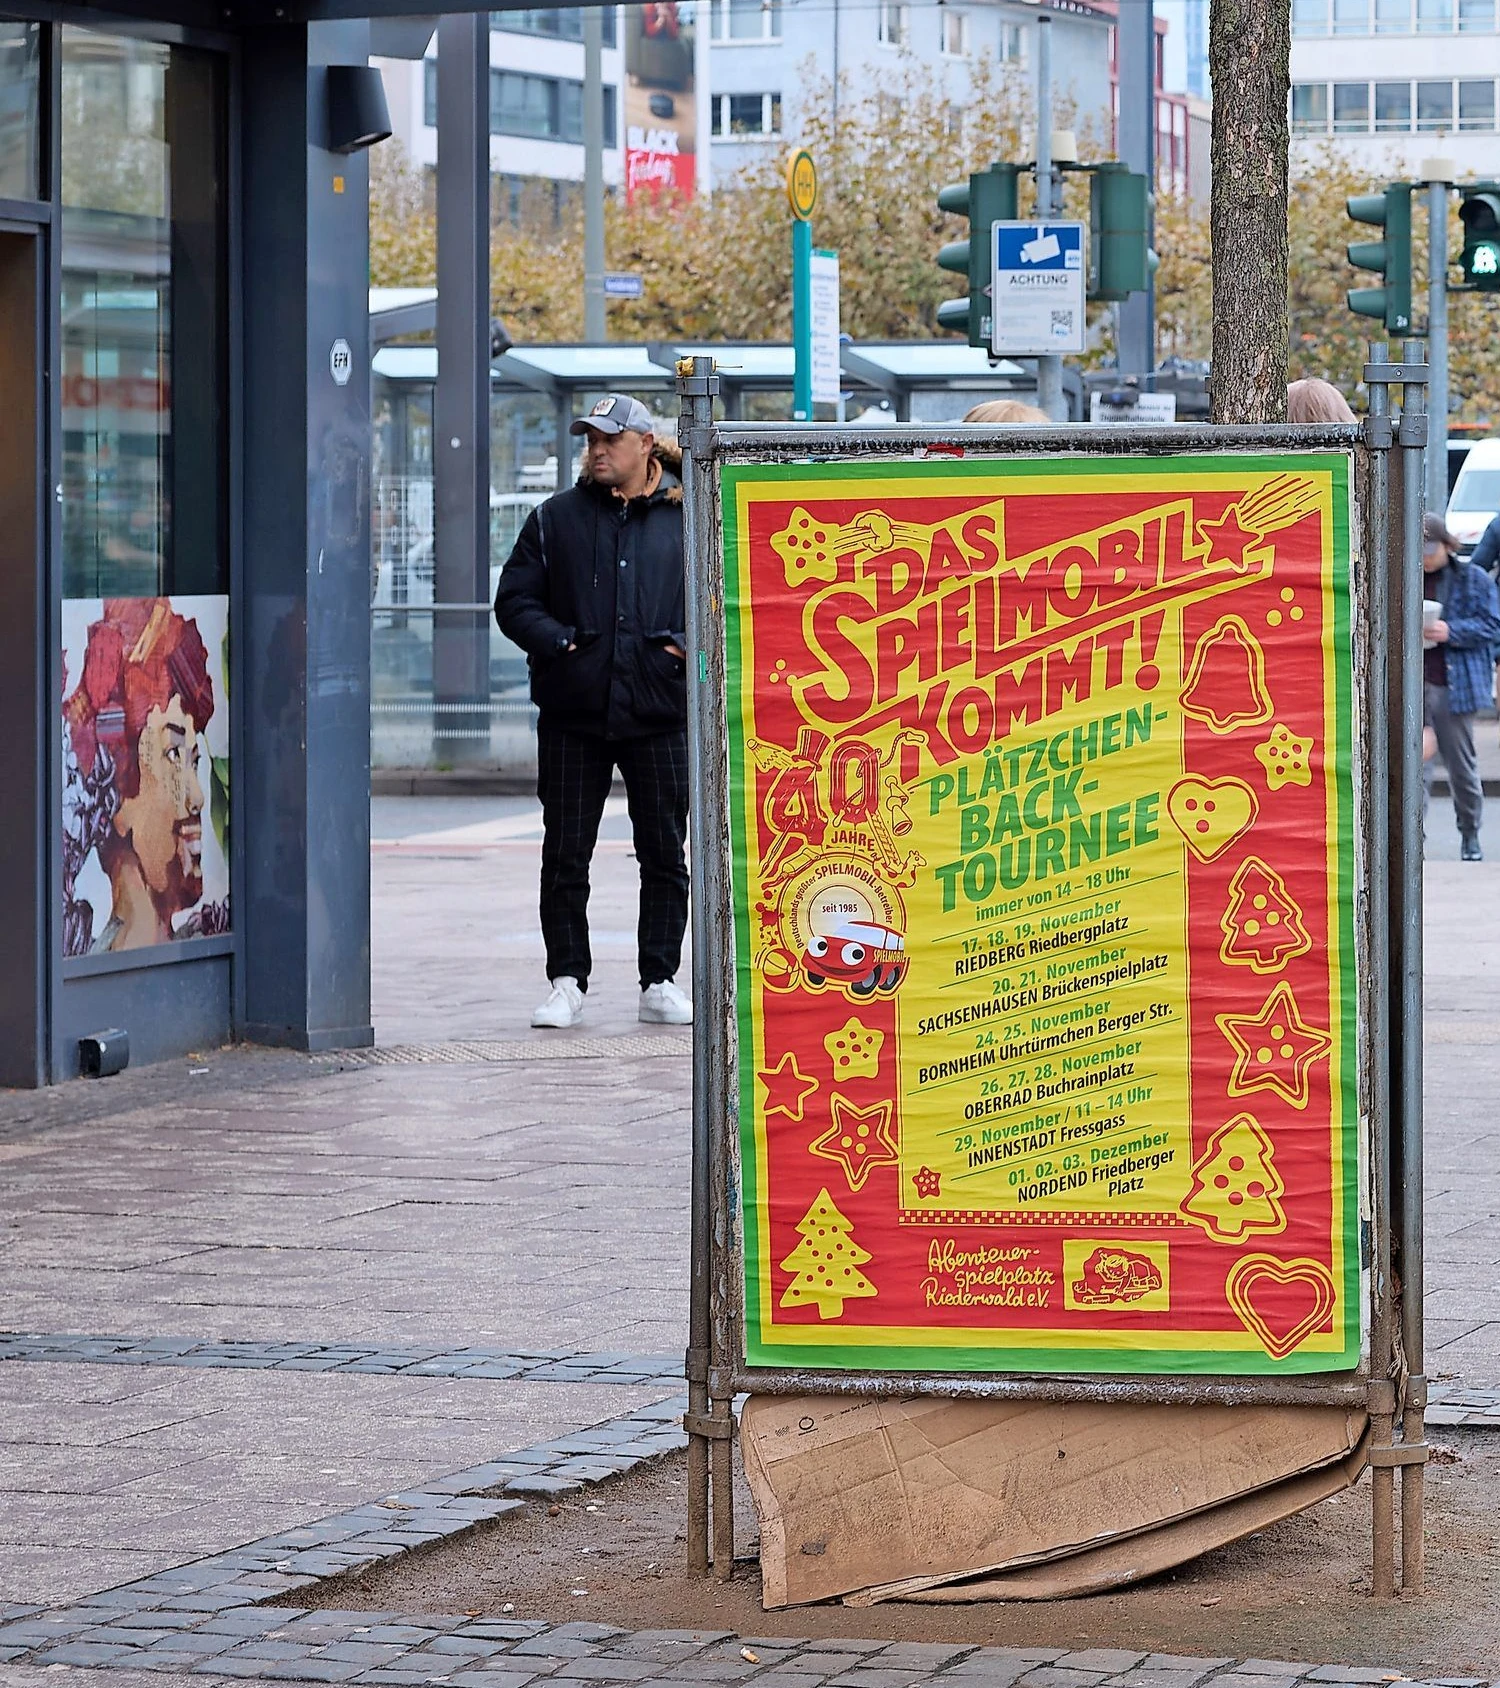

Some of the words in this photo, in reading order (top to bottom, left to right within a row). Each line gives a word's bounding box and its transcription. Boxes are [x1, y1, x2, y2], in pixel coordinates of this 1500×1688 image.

[1009, 275, 1069, 285] ACHTUNG
[863, 515, 999, 613] DAS
[802, 510, 1206, 723] SPIELMOBIL
[838, 609, 1166, 785] KOMMT!
[920, 702, 1168, 816] PLÄTZCHEN-
[960, 767, 1098, 855] BACK-
[831, 830, 875, 852] JAHRE
[935, 791, 1160, 913] TOURNEE
[795, 875, 816, 901] größter
[822, 904, 838, 913] seit
[839, 904, 858, 913] 1985
[976, 899, 1023, 921] immer
[1026, 891, 1052, 908] von
[1055, 882, 1071, 900] 14
[1085, 873, 1102, 891] 18
[1105, 866, 1131, 884] Uhr
[789, 900, 805, 949] Deutschlands
[955, 943, 1026, 976] RIEDBERG
[1029, 917, 1129, 956] Riedbergplatz
[962, 939, 982, 955] 17.
[987, 931, 1009, 949] 18.
[1014, 923, 1036, 940] 19.
[1040, 898, 1121, 932] November
[917, 988, 1038, 1036] SACHSENHAUSEN
[1042, 954, 1168, 1001] Brückenspielplatz
[992, 978, 1015, 995] 20.
[1020, 970, 1042, 987] 21.
[1046, 946, 1127, 980] November
[919, 1048, 996, 1084] BORNHEIM
[999, 1024, 1094, 1061] Uhrtürmchen
[1098, 1013, 1146, 1035] Berger
[1149, 1002, 1173, 1020] Str.
[975, 1032, 999, 1049] 24.
[1003, 1023, 1026, 1041] 25.
[1031, 999, 1111, 1034] November
[964, 1088, 1032, 1120] OBERRAD
[1036, 1061, 1135, 1100] Buchrainplatz
[980, 1081, 1004, 1097] 26.
[1008, 1072, 1030, 1088] 27.
[1034, 1064, 1057, 1080] 28.
[1062, 1040, 1142, 1074] November
[954, 1137, 977, 1153] 29.
[982, 1110, 1061, 1146] November
[1064, 1106, 1071, 1124] /
[1075, 1103, 1091, 1119] 11
[1107, 1093, 1123, 1110] 14
[1127, 1086, 1153, 1105] Uhr
[968, 1130, 1056, 1168] INNENSTADT
[1060, 1113, 1126, 1144] Fressgass
[1008, 1170, 1031, 1187] 01.
[1035, 1162, 1058, 1179] 02.
[1063, 1155, 1085, 1171] 03.
[1090, 1131, 1169, 1164] Dezember
[1017, 1170, 1088, 1204] NORDEND
[1092, 1148, 1175, 1184] Friedberger
[1108, 1176, 1144, 1198] Platz
[927, 1238, 1040, 1273] Abenteuer-
[955, 1265, 1055, 1290] spielplatz
[920, 1277, 1026, 1308] Riederwald
[1027, 1289, 1049, 1309] e.V.
